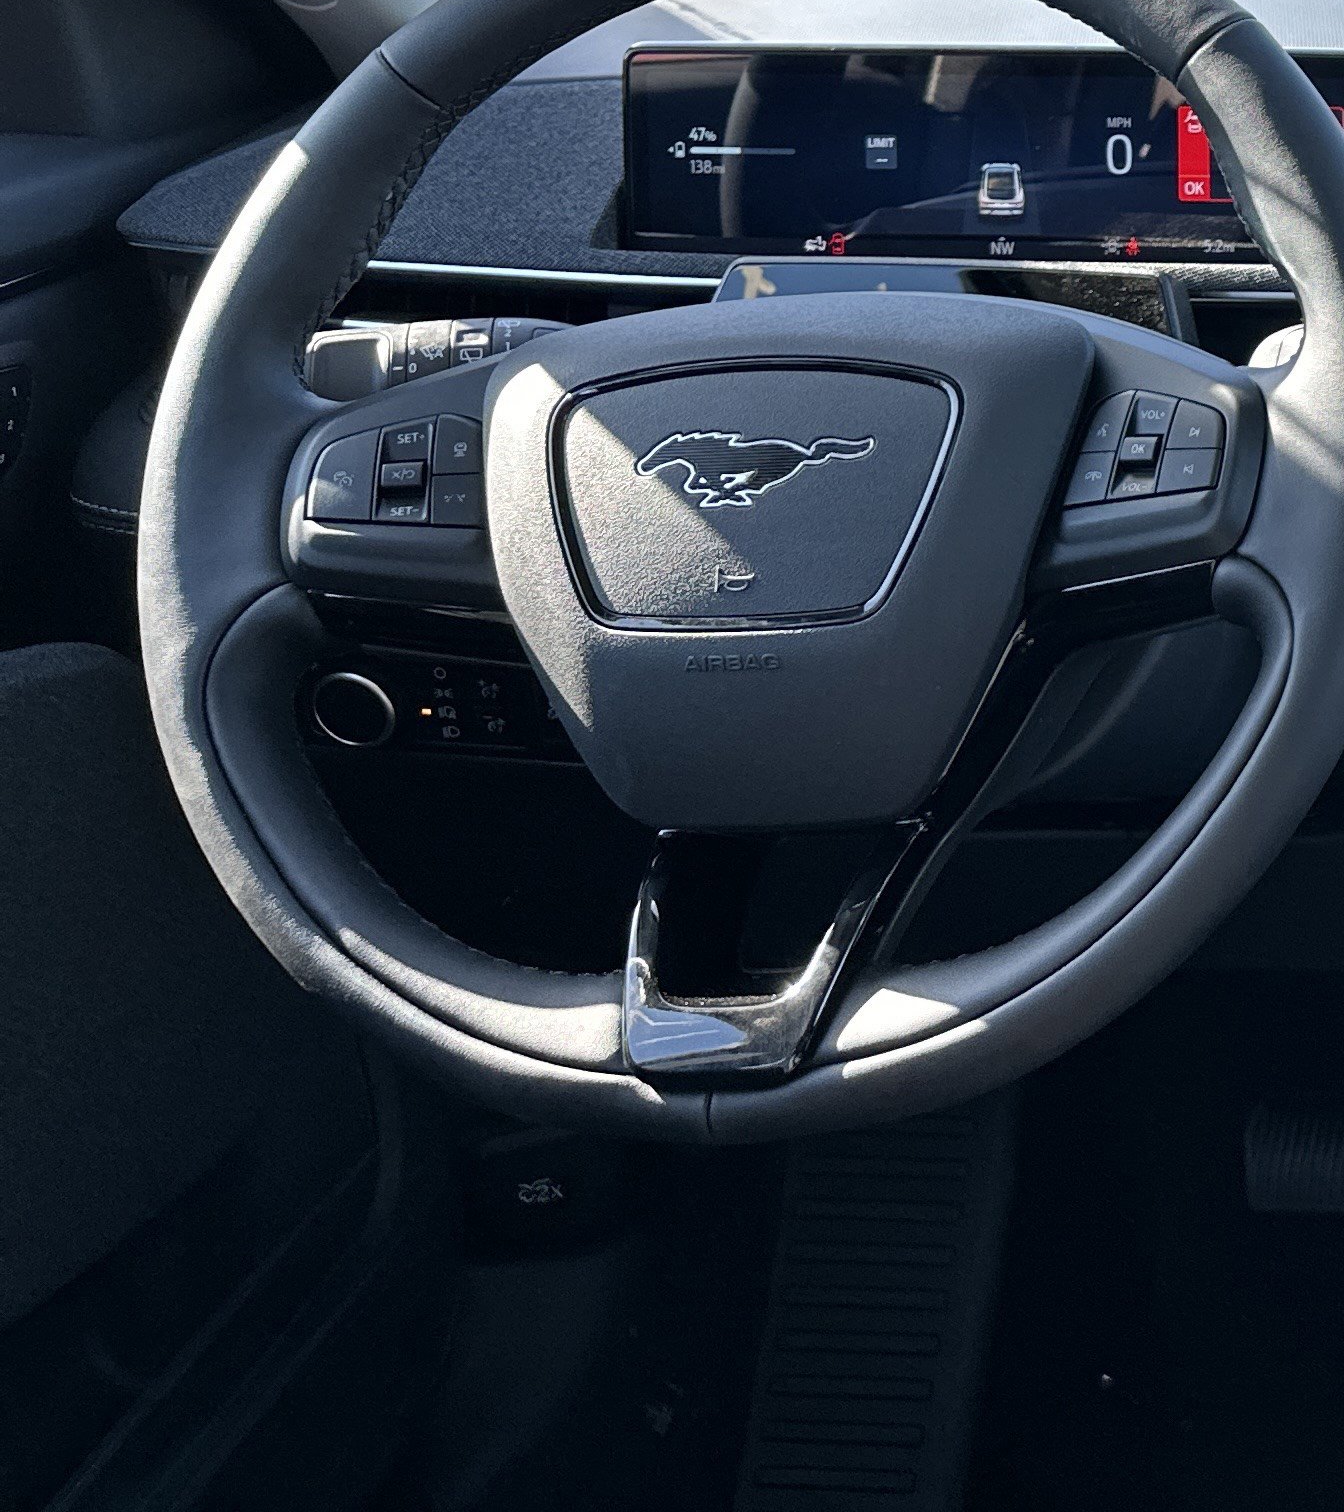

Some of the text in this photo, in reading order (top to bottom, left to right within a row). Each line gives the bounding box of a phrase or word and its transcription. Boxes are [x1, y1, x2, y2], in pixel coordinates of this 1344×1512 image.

[1107, 117, 1132, 128] MPH
[689, 127, 717, 141] 47%
[867, 137, 896, 149] LIMIT
[1106, 134, 1133, 175] 0
[1184, 181, 1205, 196] OK
[990, 242, 1015, 255] NW
[397, 432, 425, 444] SET+
[1131, 444, 1145, 454] OK
[685, 653, 780, 672] AIRBAG
